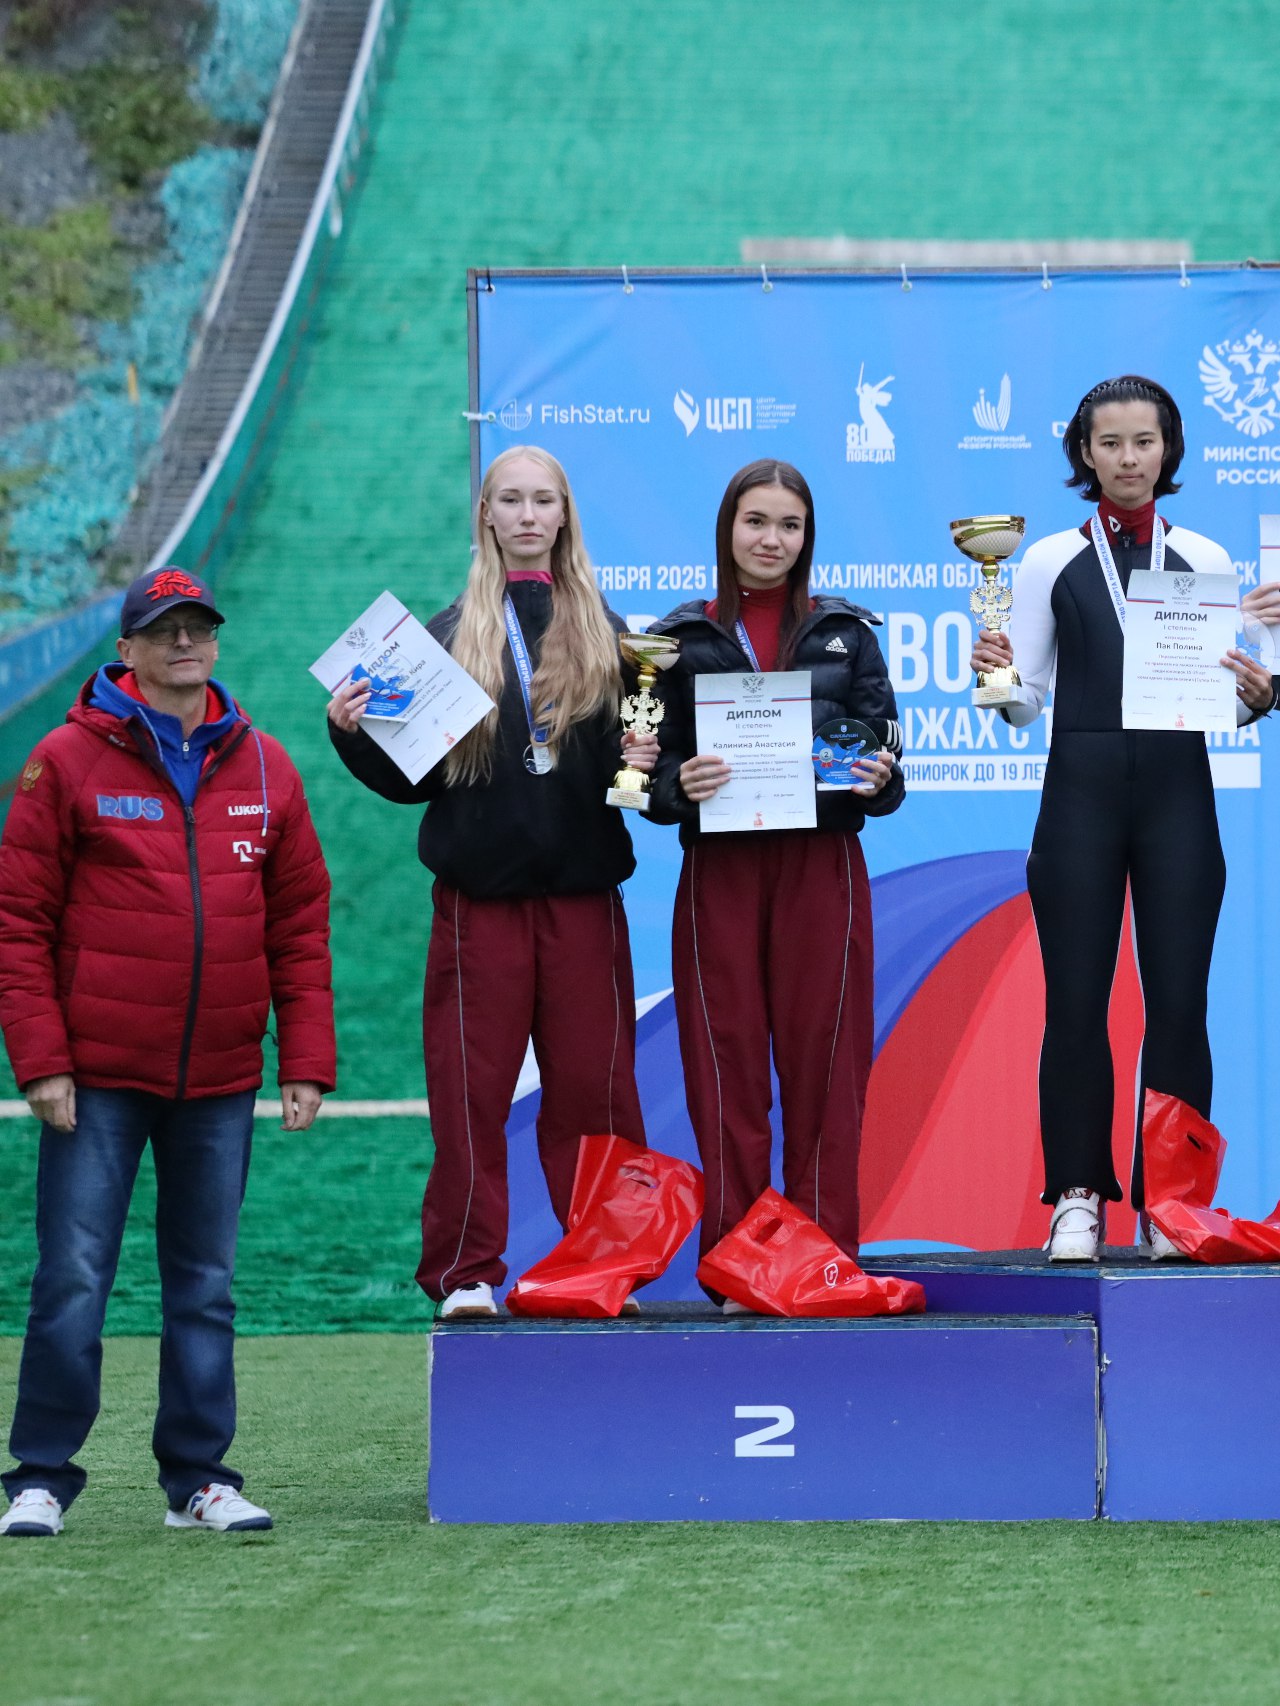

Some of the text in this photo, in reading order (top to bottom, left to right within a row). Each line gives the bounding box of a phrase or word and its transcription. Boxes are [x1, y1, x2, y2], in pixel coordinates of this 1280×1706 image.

[541, 404, 650, 424] FishStat.ru
[706, 397, 751, 432] ЦСП
[846, 449, 895, 463] ПОБЕДА!
[592, 565, 650, 590] ТЯБРЯ
[657, 565, 706, 590] 2025
[808, 563, 1020, 588] АХАЛИНСКАЯ ОБЛСТ
[1154, 611, 1207, 622] ДИПЛОМ
[368, 641, 401, 675] ИПЛОМ
[1173, 643, 1203, 651] Полина
[726, 709, 782, 721] ДИПЛОМ
[902, 707, 998, 750] ЖАХ
[974, 763, 995, 782] ДО
[1002, 763, 1017, 780] 19
[96, 794, 164, 821] RUS
[735, 1405, 795, 1457] 2
